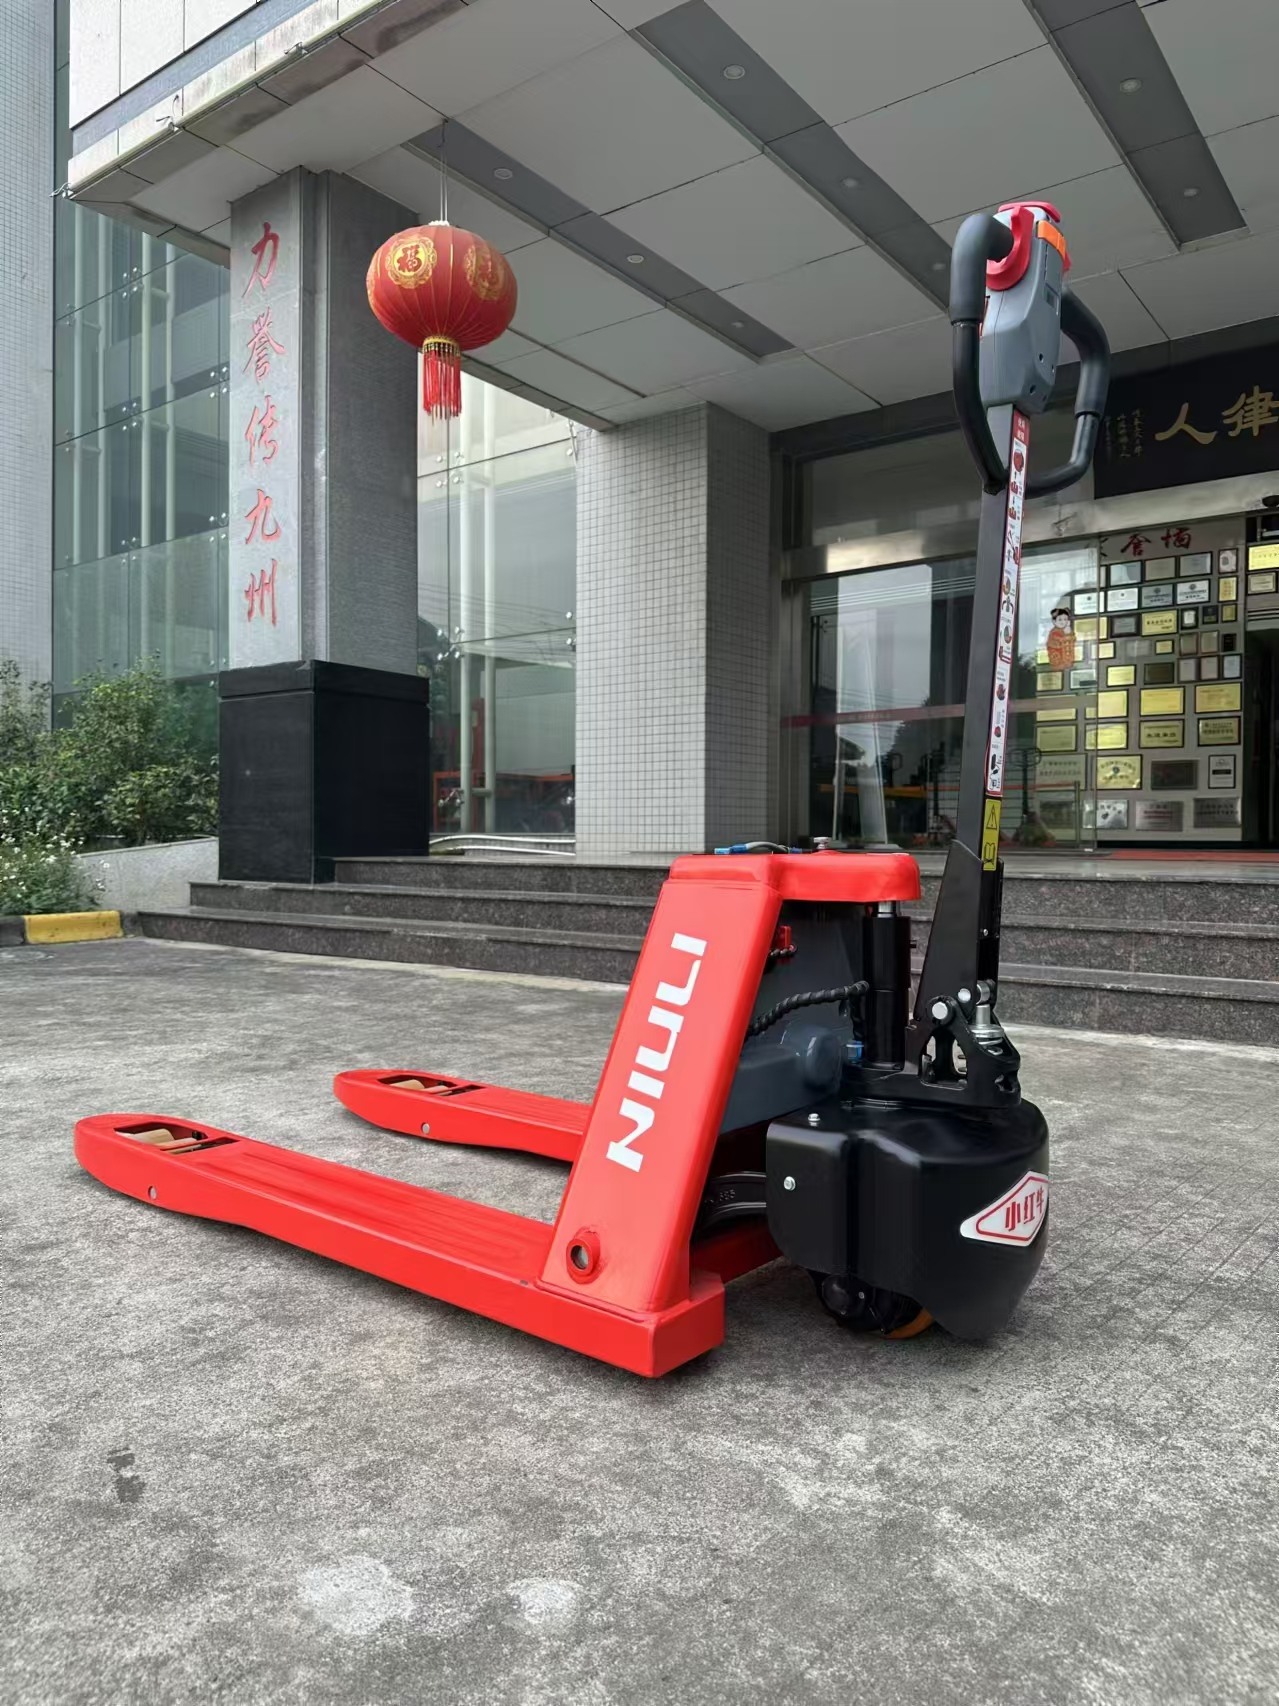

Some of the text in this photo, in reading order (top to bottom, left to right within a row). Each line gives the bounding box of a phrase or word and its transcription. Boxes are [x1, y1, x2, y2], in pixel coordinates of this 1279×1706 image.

[397, 244, 422, 272] 福
[606, 932, 708, 1173] NIULI
[1004, 1184, 1045, 1232] 小红牛
